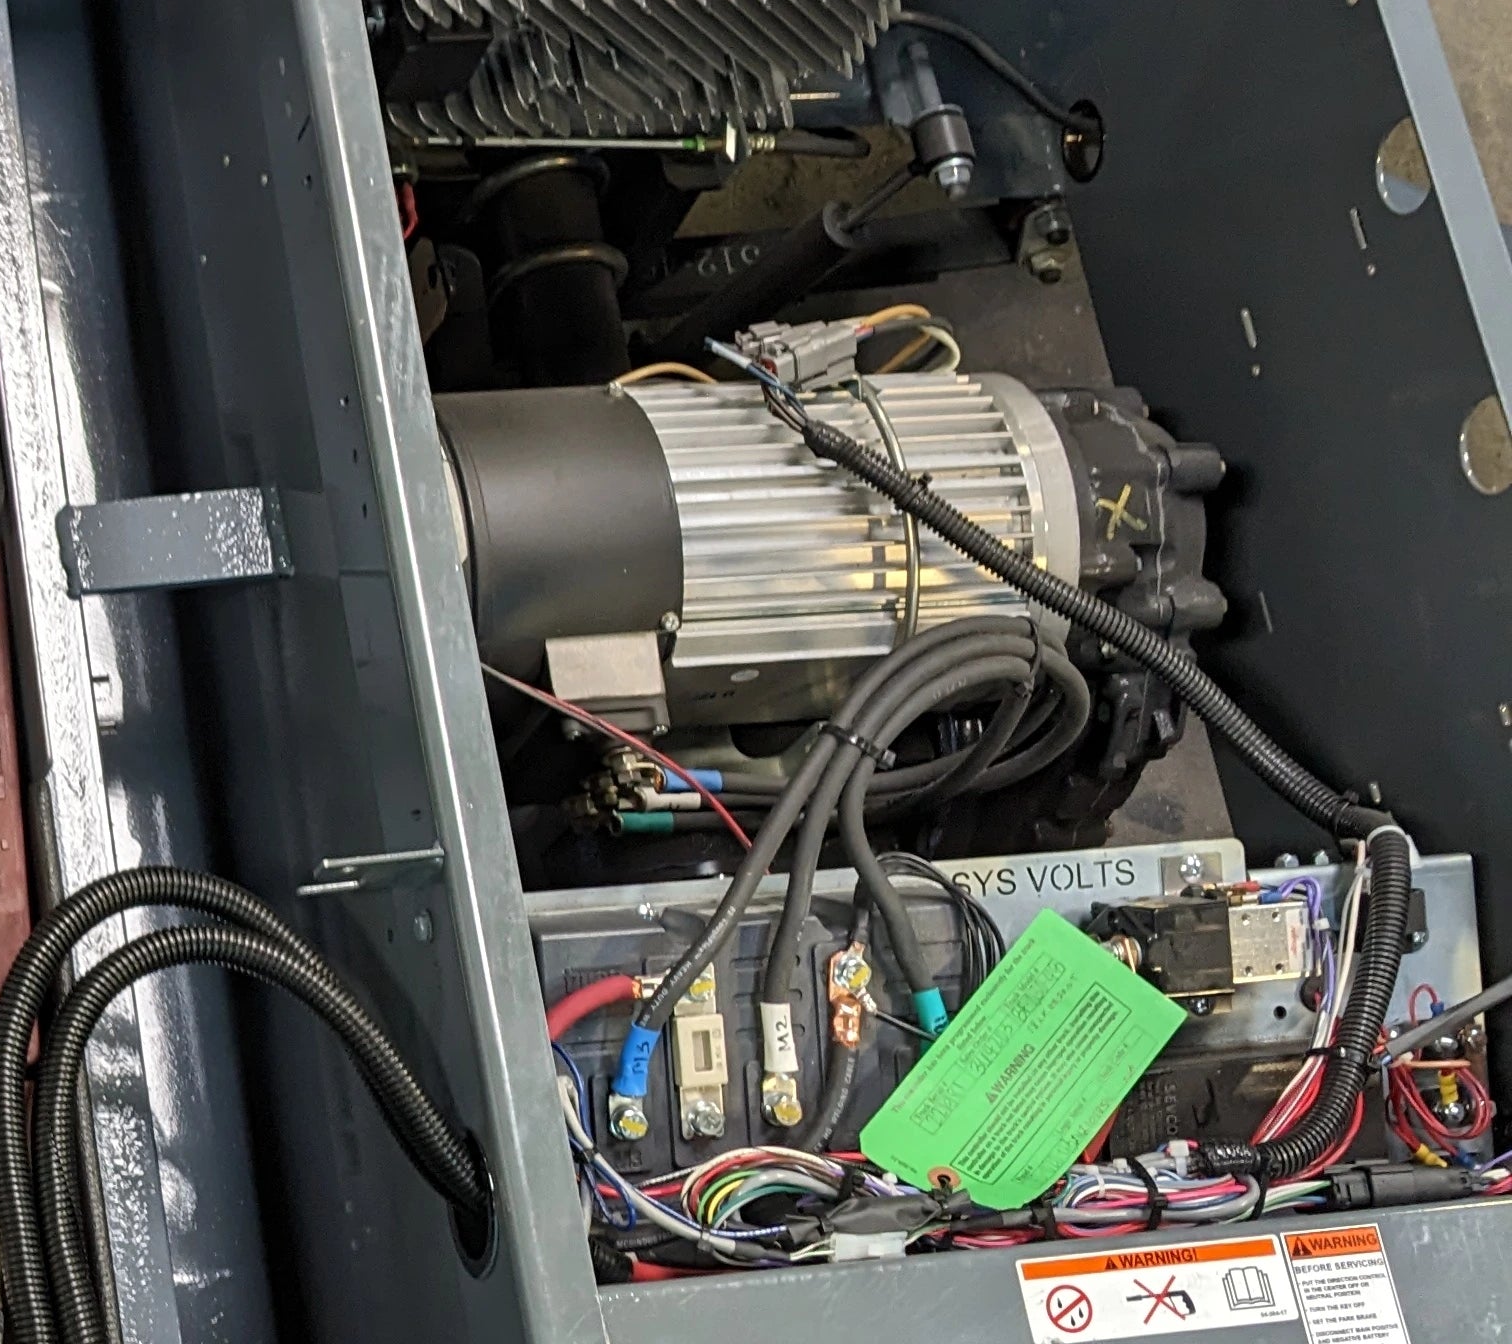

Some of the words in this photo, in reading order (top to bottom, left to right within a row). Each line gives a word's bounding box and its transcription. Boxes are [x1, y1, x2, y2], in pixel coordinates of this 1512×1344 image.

[951, 869, 1017, 897] SYS
[1027, 858, 1137, 894] VOLTS
[776, 1015, 793, 1052] M2
[989, 1041, 1036, 1094] WARNING
[1308, 1232, 1378, 1251] WARNING
[1118, 1247, 1198, 1269] WARNING!
[1294, 1262, 1332, 1274] BEFORE
[1333, 1256, 1384, 1270] SERVICING
[1308, 1305, 1325, 1313] TURN
